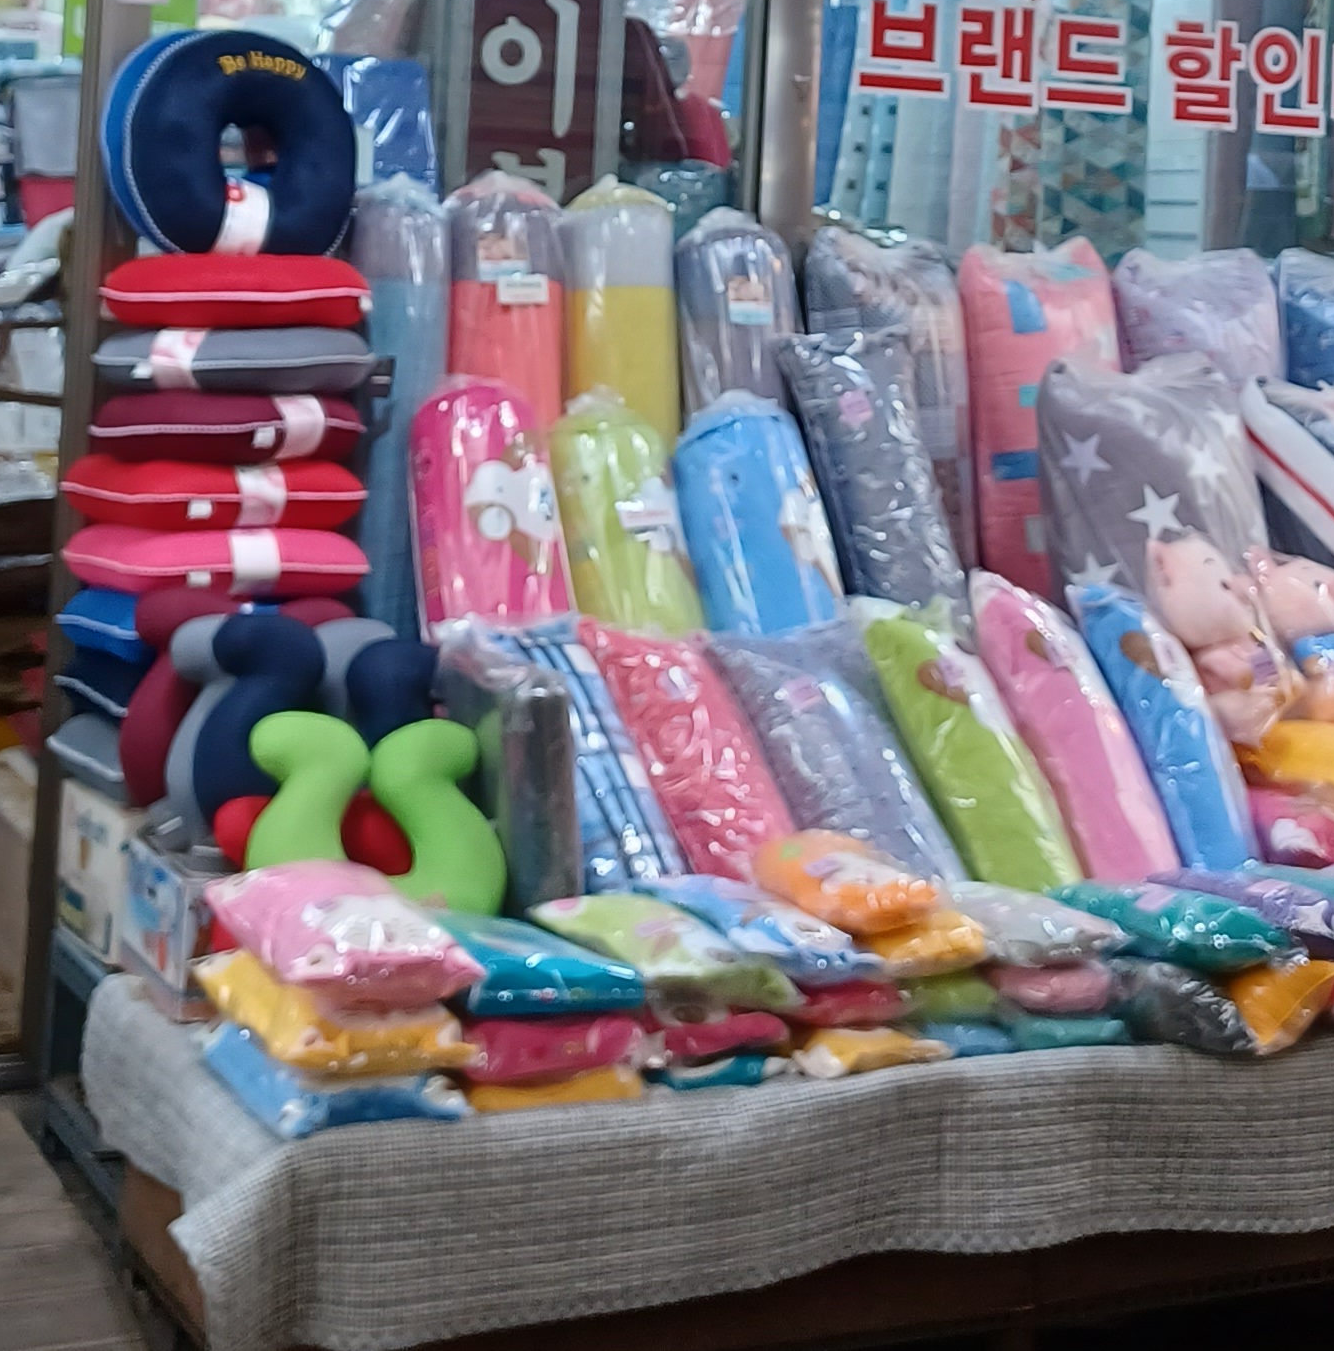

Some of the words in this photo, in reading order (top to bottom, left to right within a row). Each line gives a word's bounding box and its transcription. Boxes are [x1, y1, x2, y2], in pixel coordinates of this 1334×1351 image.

[217, 55, 247, 76] Be
[247, 50, 307, 81] Happy
[859, 0, 1131, 111] 브랜드
